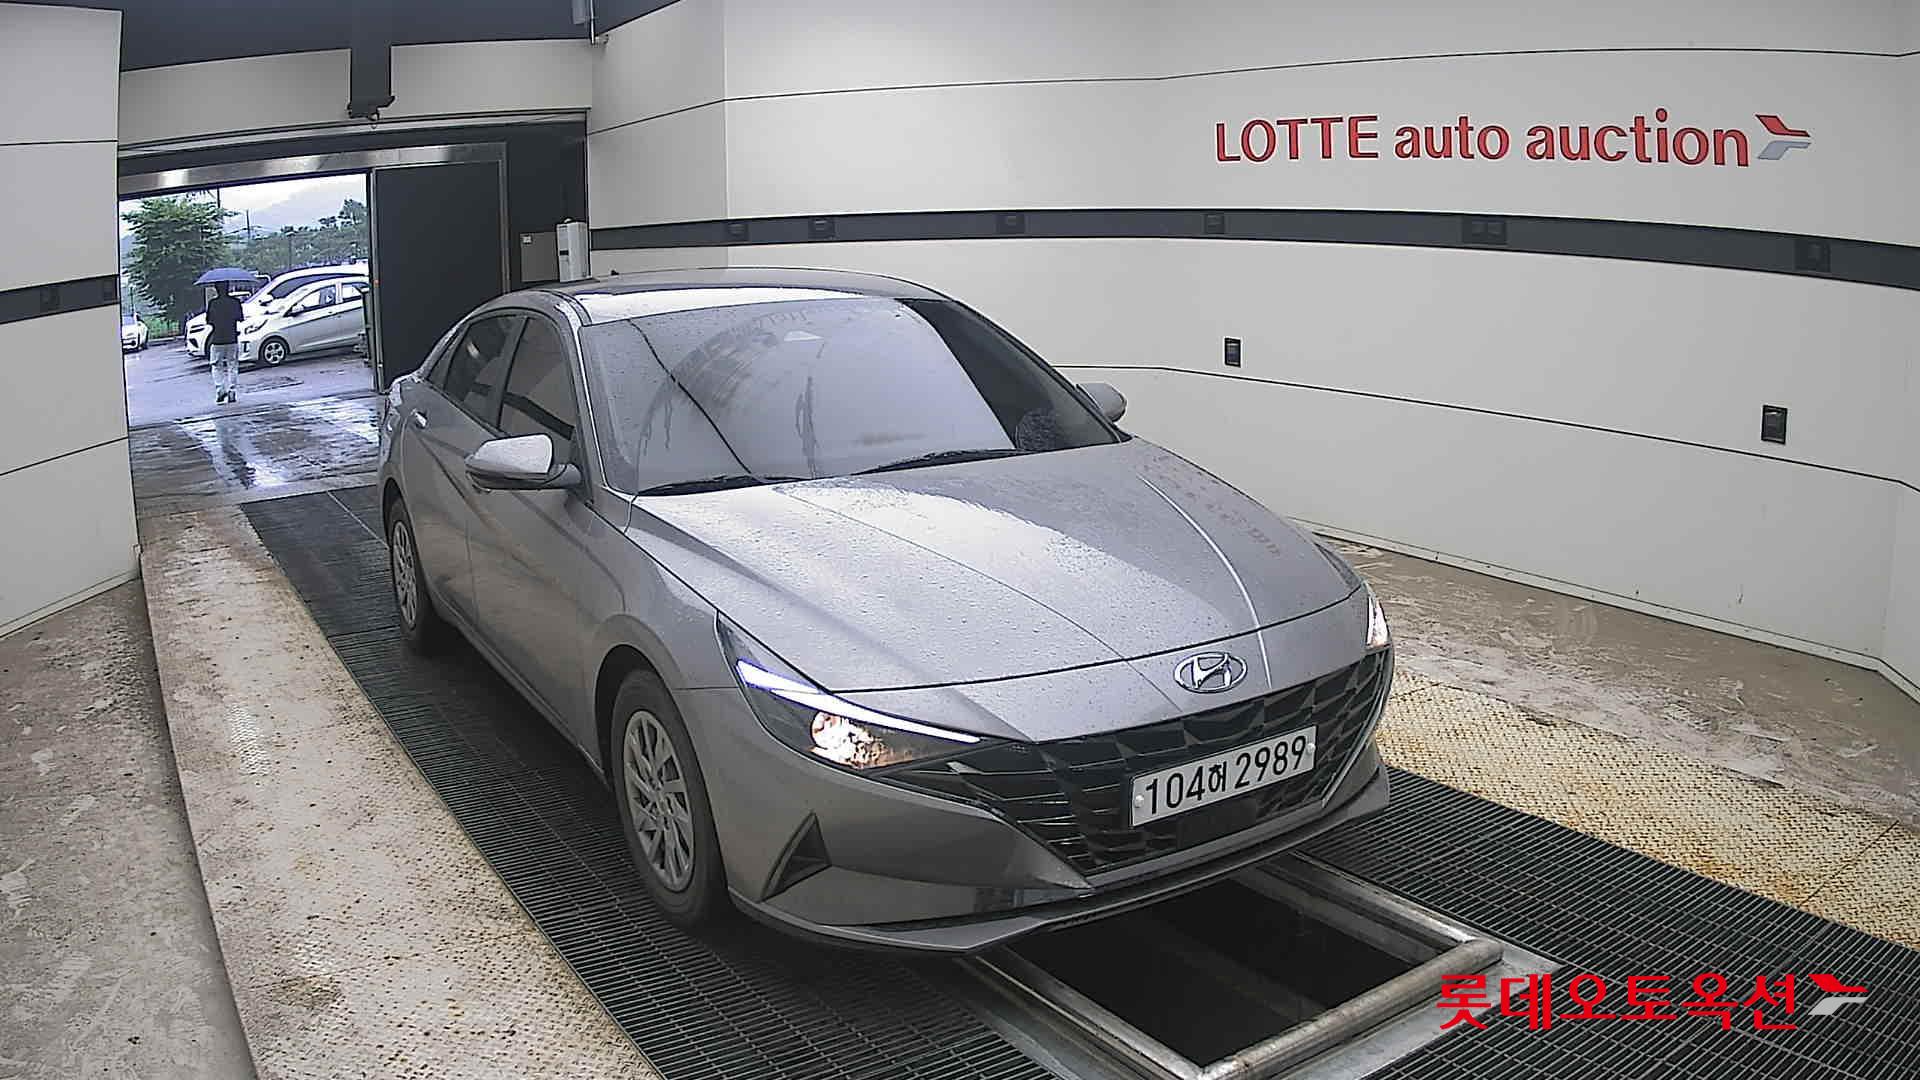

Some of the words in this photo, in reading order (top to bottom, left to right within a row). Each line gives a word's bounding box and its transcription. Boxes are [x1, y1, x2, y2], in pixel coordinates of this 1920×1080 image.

[1216, 115, 1378, 162] LOTTE
[1394, 116, 1511, 160] auto
[1525, 108, 1750, 167] auction
[1146, 761, 1227, 814] 104허
[1234, 736, 1307, 789] 2989
